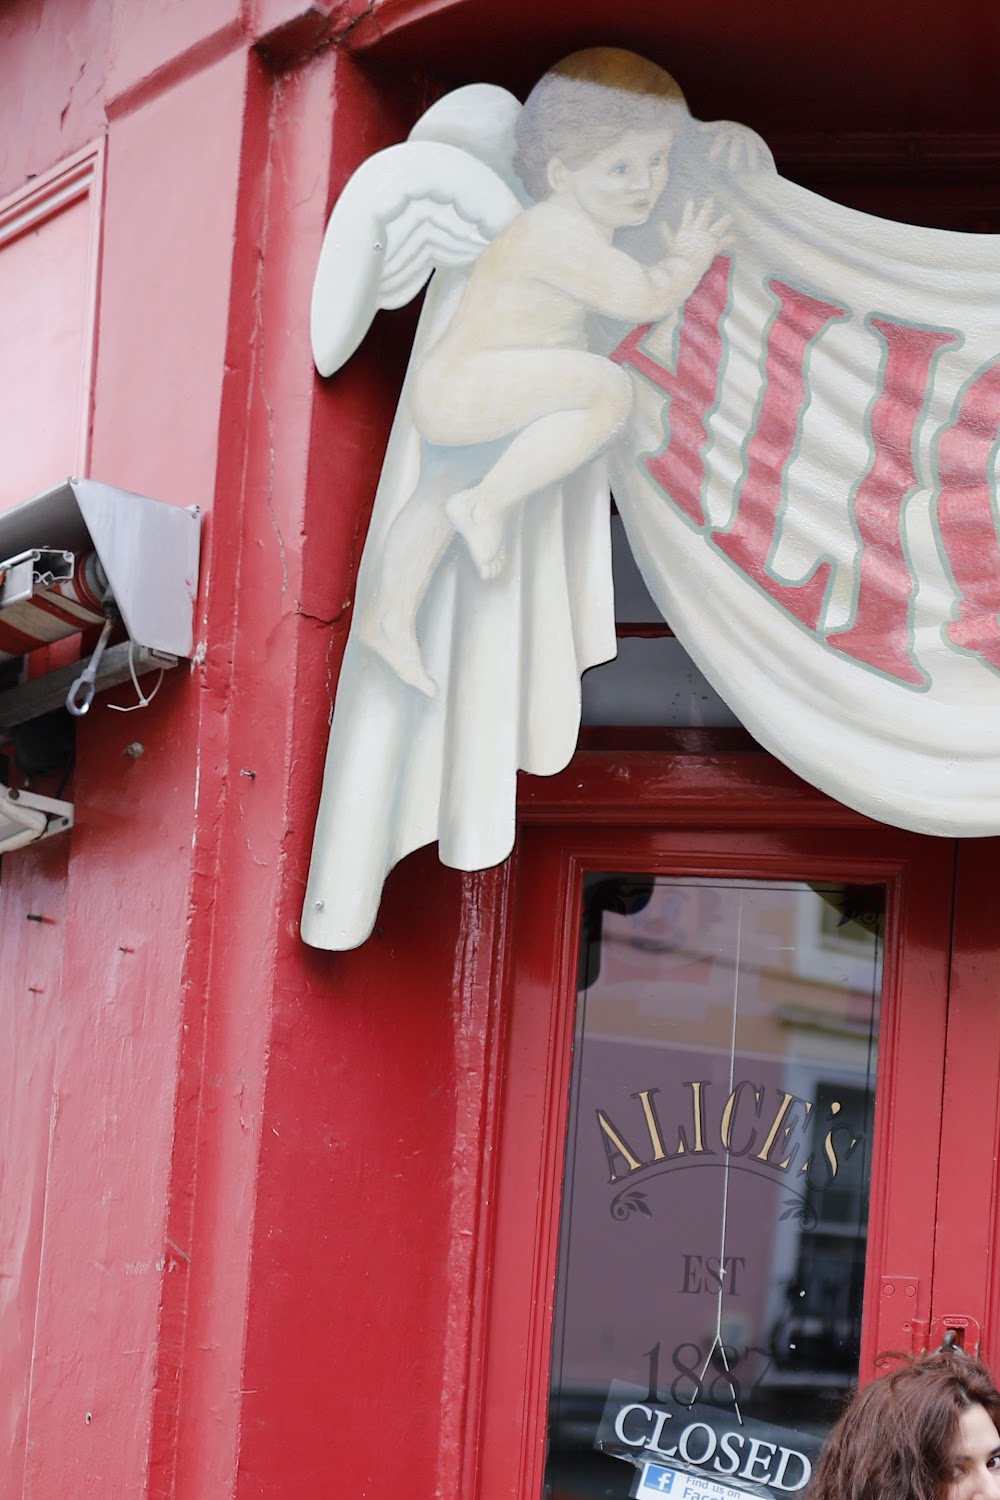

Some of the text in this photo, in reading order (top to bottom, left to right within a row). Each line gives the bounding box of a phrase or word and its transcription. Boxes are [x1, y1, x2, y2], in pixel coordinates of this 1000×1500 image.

[595, 1079, 863, 1192] ALICE'S
[677, 1253, 746, 1297] EST
[614, 1403, 813, 1492] CLOSED
[685, 1476, 741, 1500] Find us on
